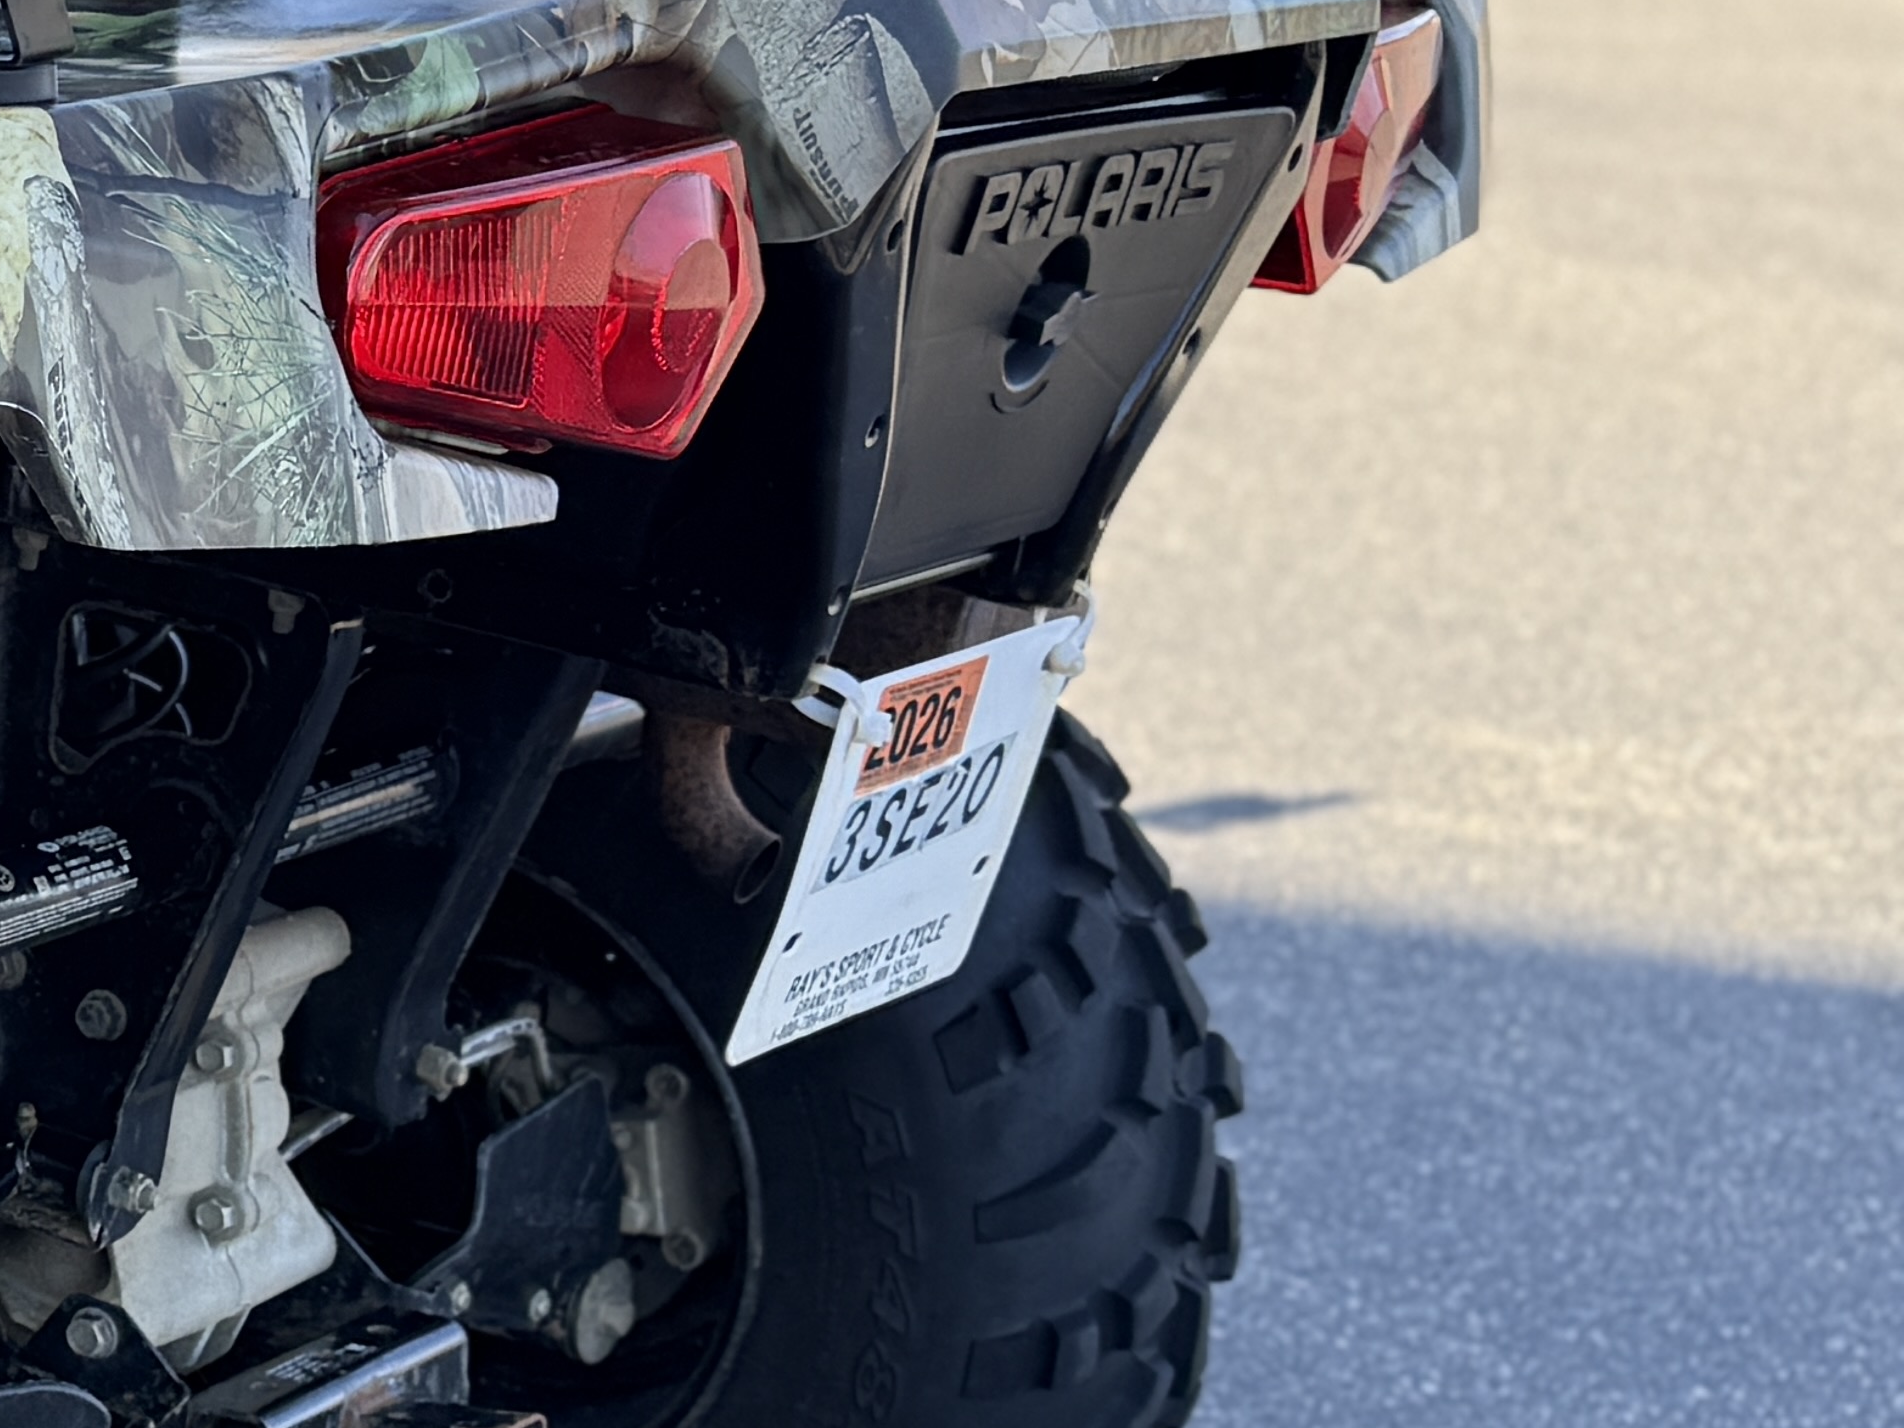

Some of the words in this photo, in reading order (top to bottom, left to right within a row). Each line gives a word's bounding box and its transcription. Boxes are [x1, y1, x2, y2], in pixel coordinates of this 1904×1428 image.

[960, 140, 1236, 256] POLARIS
[833, 937, 890, 984] SPORT
[899, 912, 953, 957] CYCLE
